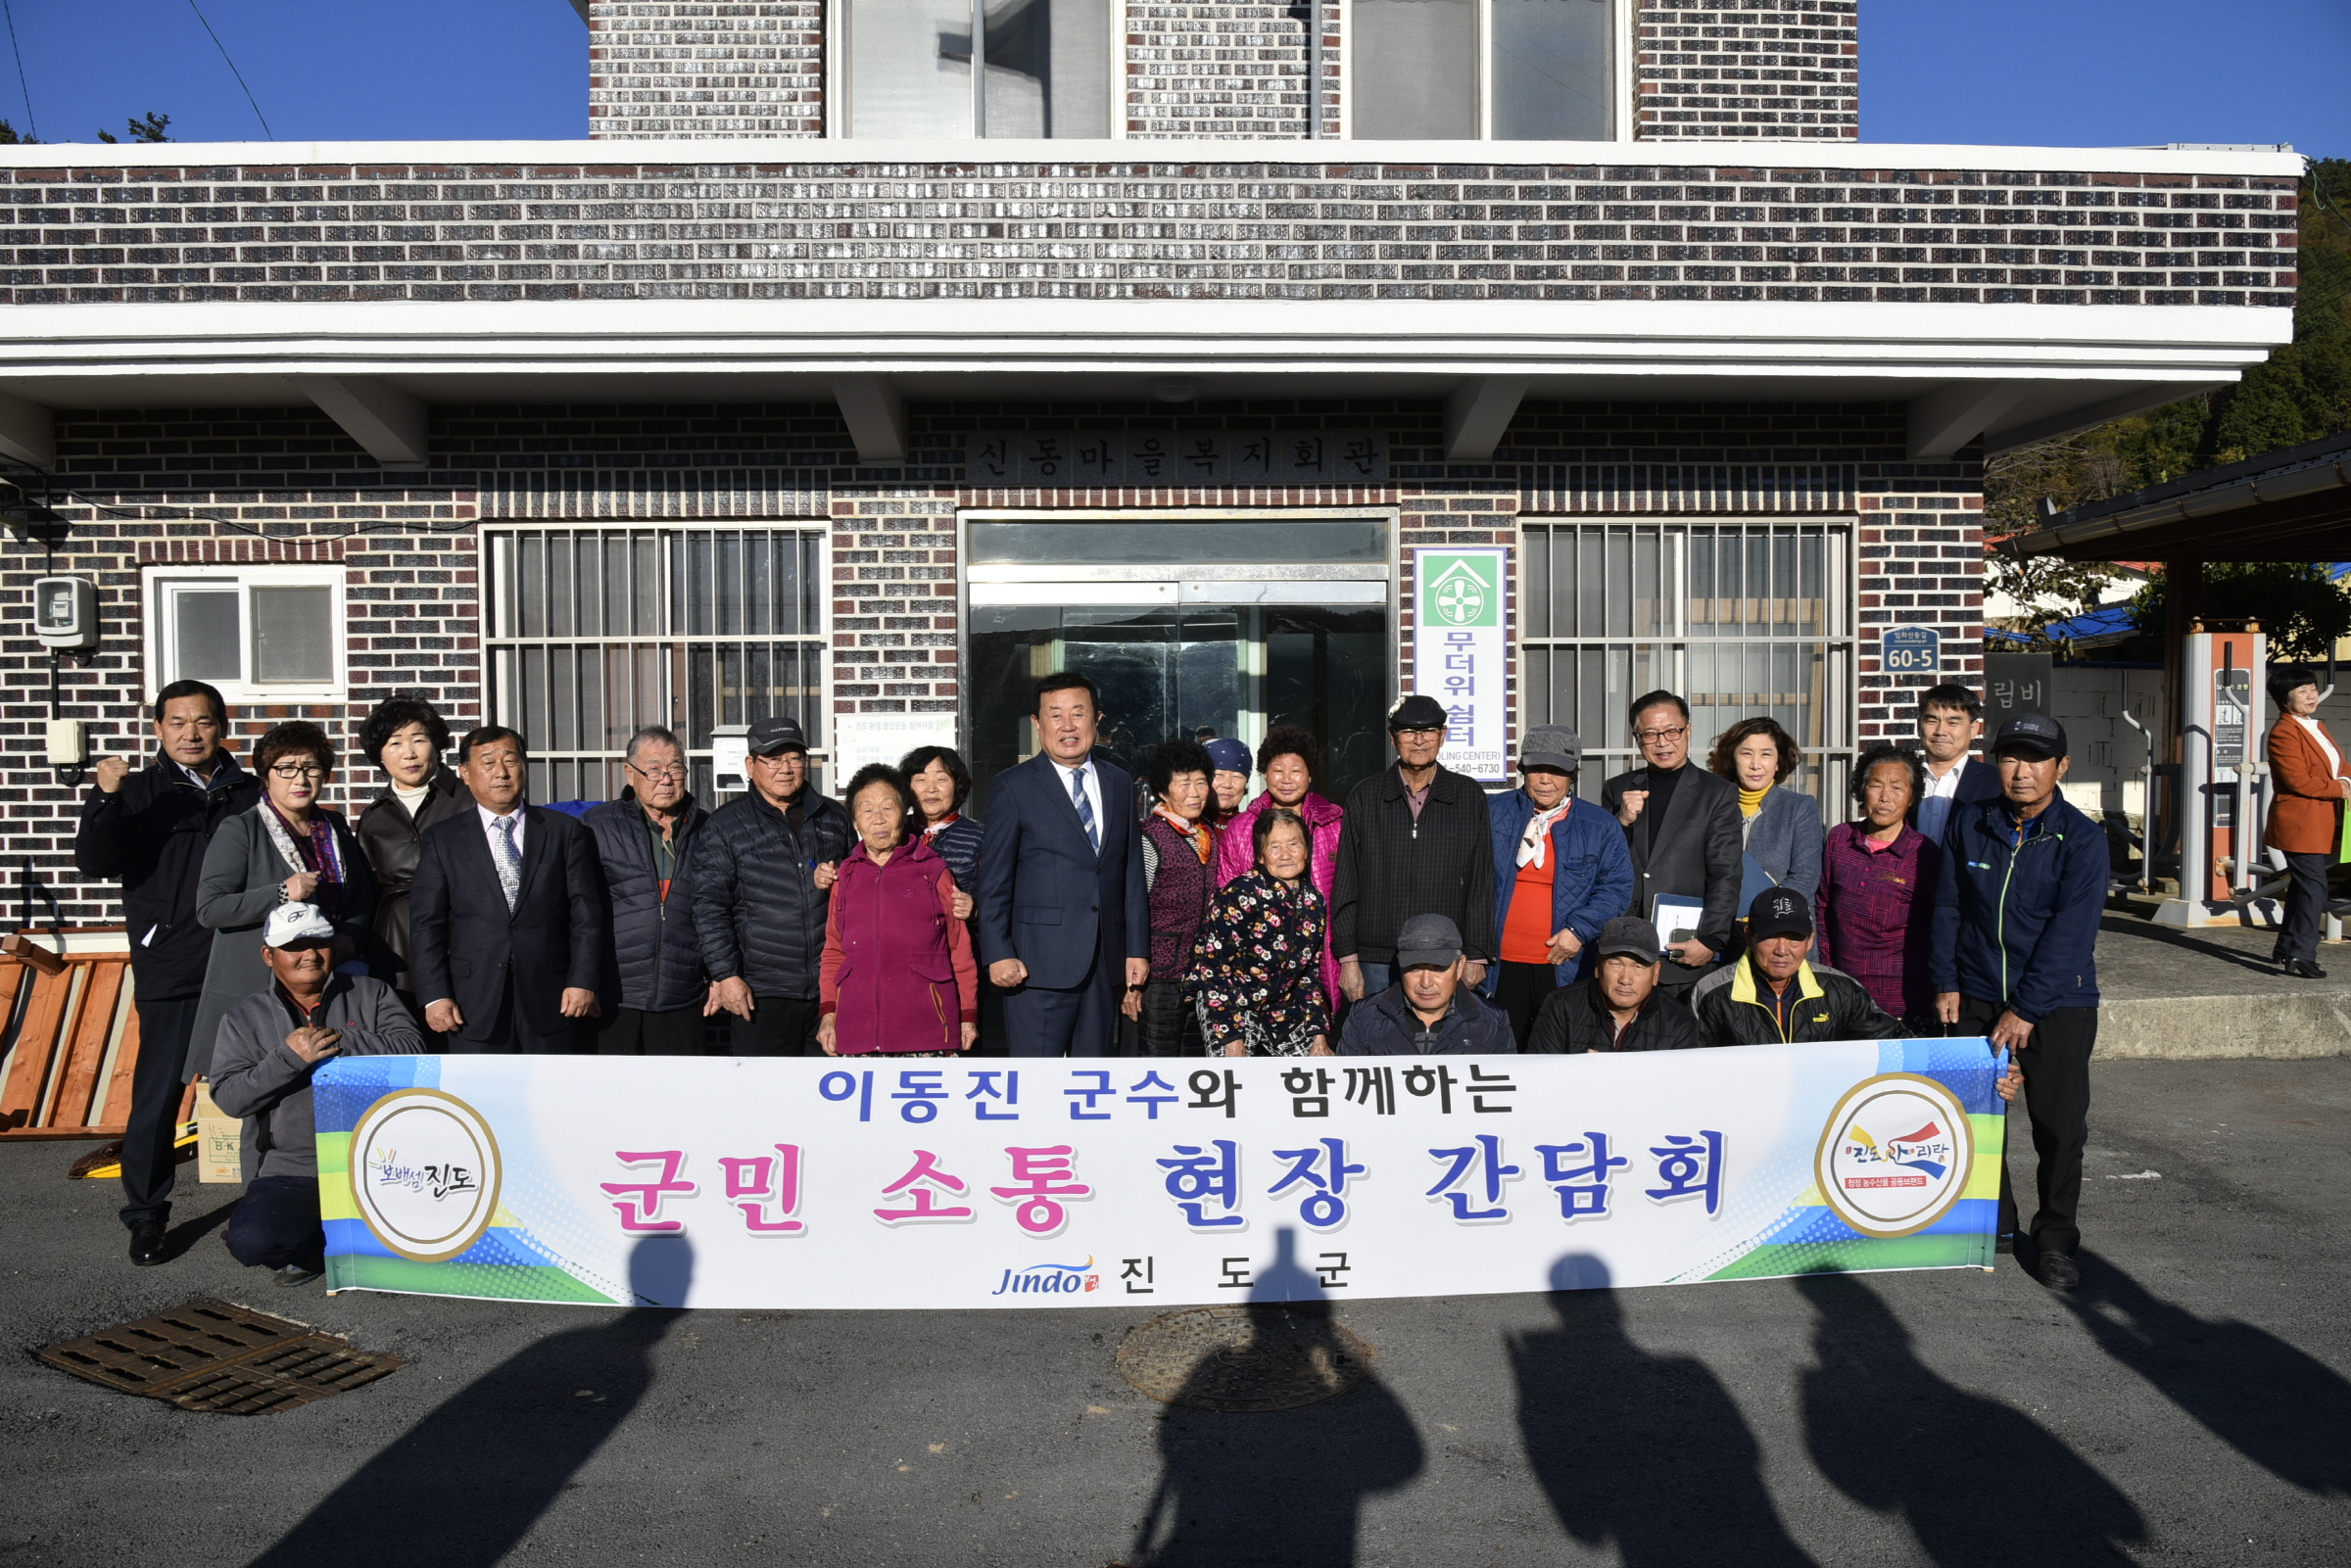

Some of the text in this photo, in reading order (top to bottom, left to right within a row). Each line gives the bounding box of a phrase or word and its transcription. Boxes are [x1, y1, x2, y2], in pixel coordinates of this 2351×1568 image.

[980, 437, 1379, 476] 신동마을복지회관
[1889, 649, 1933, 668] 60-5
[1444, 632, 1476, 747] 무더위 쉼터
[1463, 751, 1501, 761] CENTER)
[819, 1064, 1516, 1123] 이동진 군수와 함께하는
[380, 1164, 476, 1198] 보배섬 진도
[600, 1130, 1724, 1232] 군민 소통 현장 간담회
[1847, 1177, 1924, 1188] 청정 농수산물 공동브랜드
[991, 1268, 1081, 1296] Jindo
